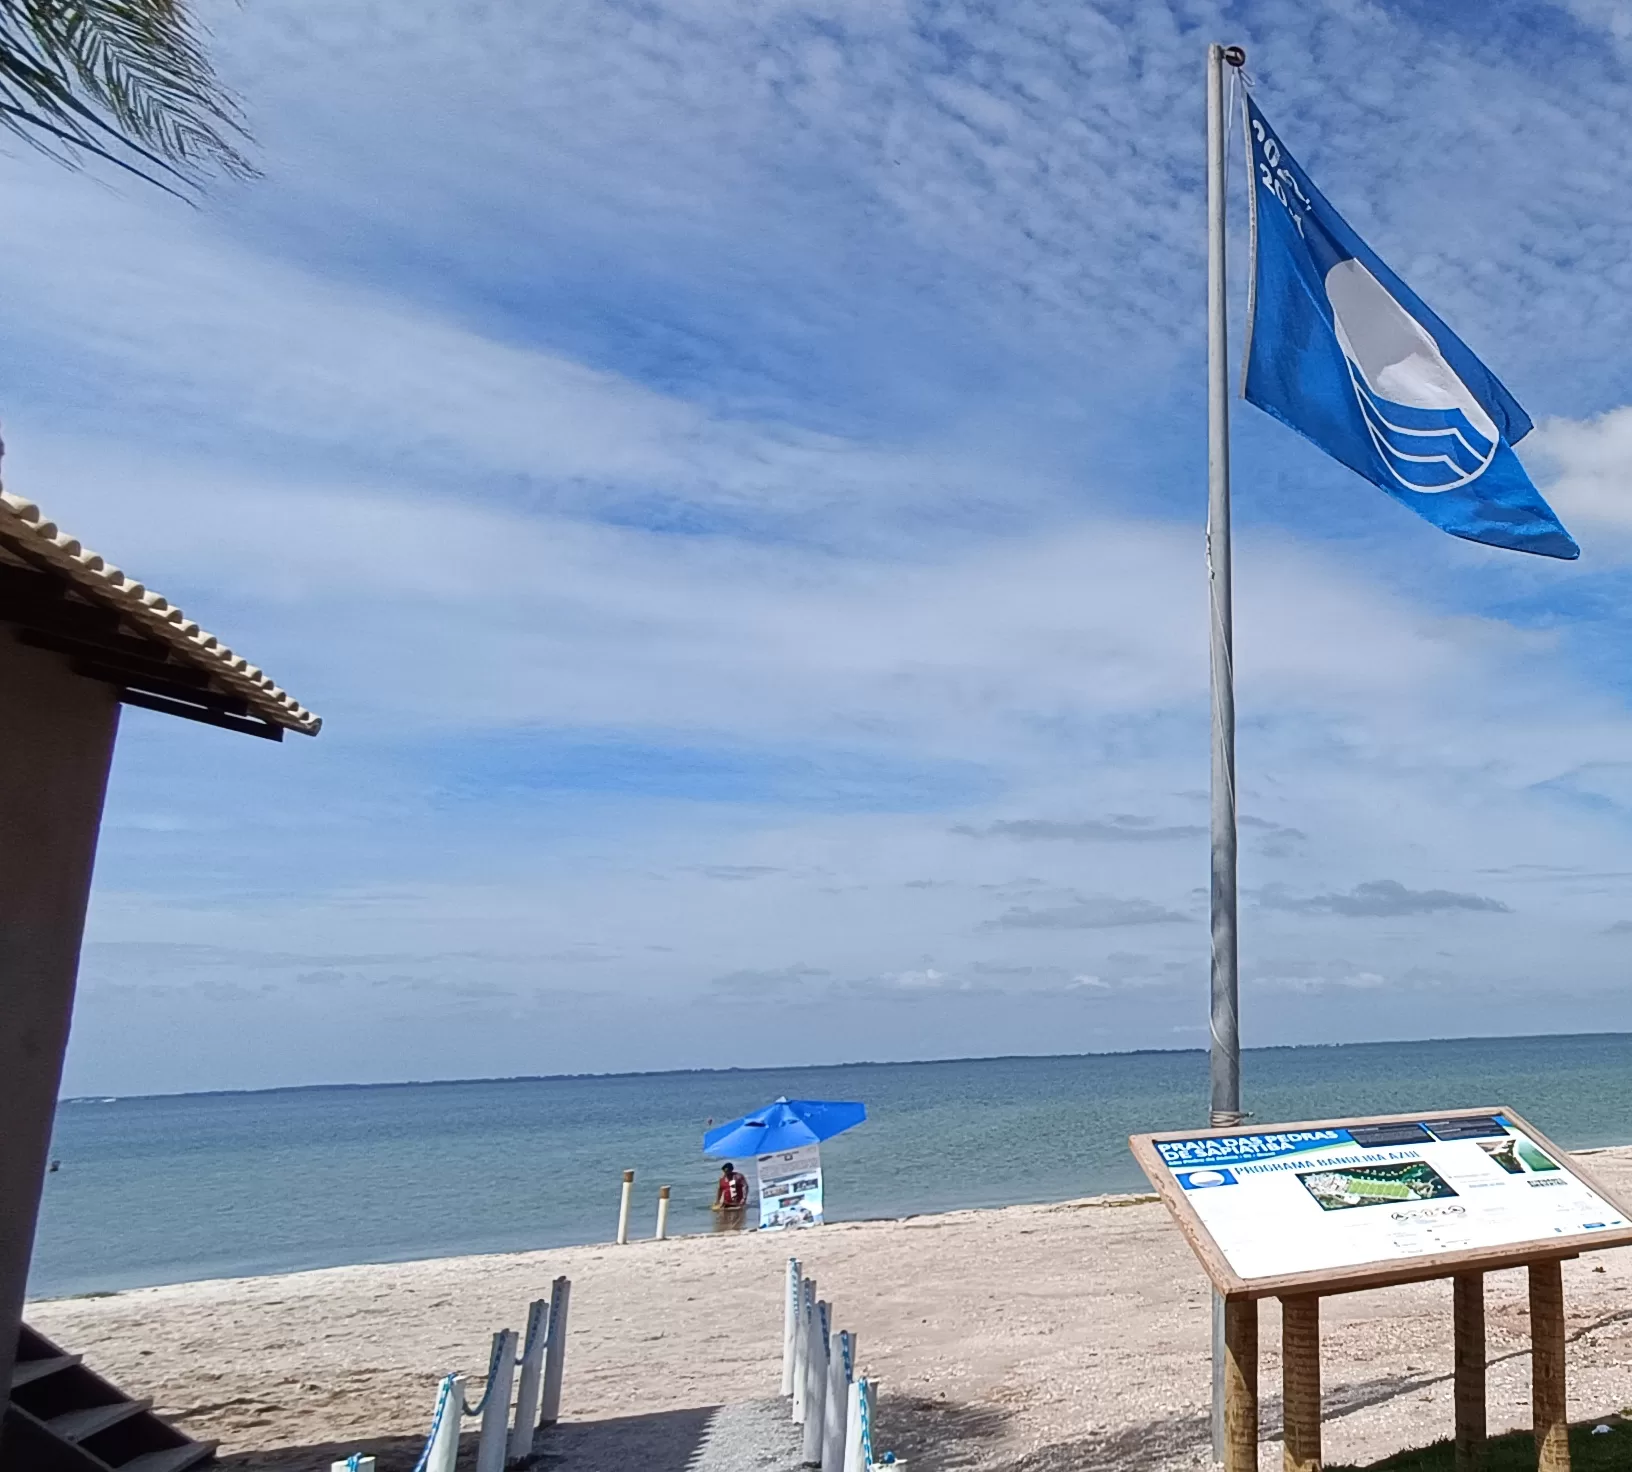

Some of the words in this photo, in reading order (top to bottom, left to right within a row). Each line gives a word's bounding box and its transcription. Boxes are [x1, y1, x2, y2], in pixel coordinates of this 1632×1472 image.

[1157, 1140, 1220, 1153] PRAIA
[1222, 1136, 1263, 1147] DAS
[1264, 1130, 1339, 1144] PEDRAS
[1163, 1149, 1193, 1161] DE
[1195, 1142, 1296, 1158] SAPIATIBA
[1234, 1159, 1315, 1175] PROGRAMA
[1317, 1153, 1386, 1167] BANDEIRA
[1388, 1150, 1422, 1160] AZUL
